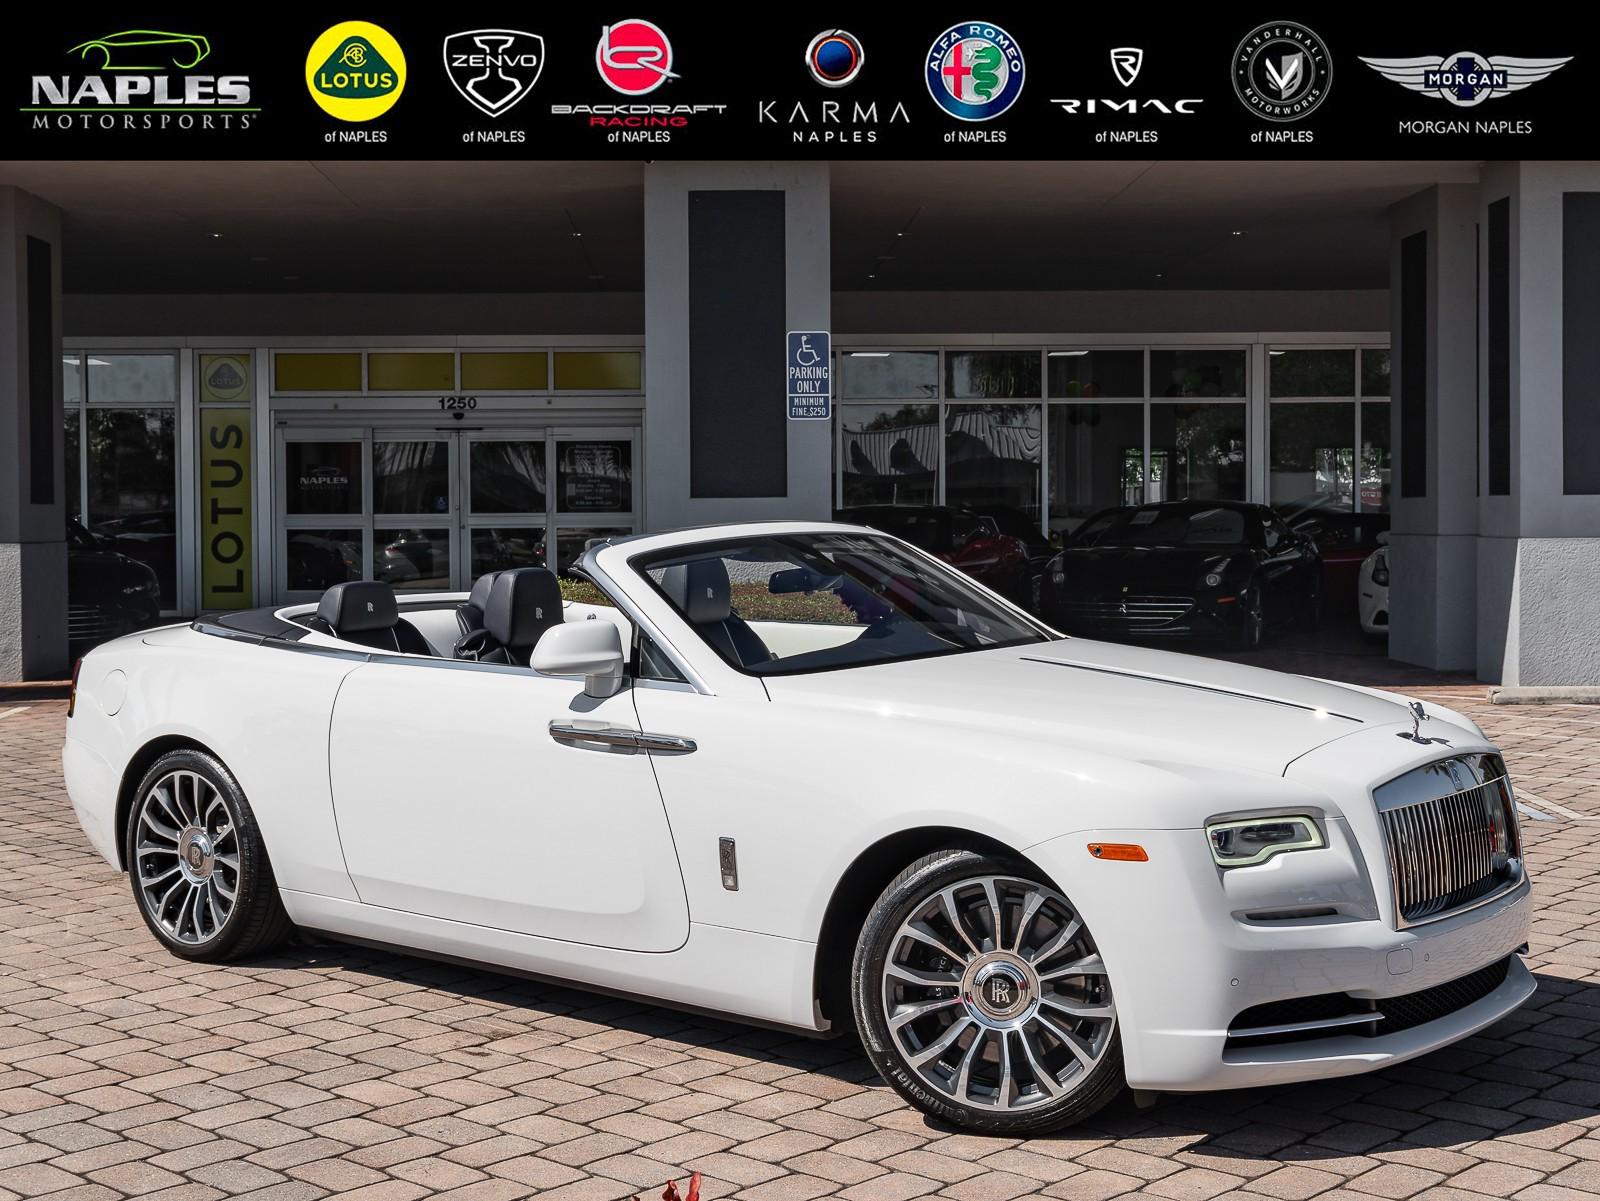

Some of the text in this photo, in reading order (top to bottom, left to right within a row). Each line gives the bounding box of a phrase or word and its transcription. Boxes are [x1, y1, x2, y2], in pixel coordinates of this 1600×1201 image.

[789, 366, 828, 379] PARKING
[796, 380, 821, 393] ONLY
[438, 397, 477, 410] 1250
[794, 397, 824, 406] MINIMUM
[792, 407, 826, 417] FINE $250
[299, 476, 349, 485] NAPLES
[209, 424, 244, 593] LOTUS
[991, 977, 1010, 1003] RR
